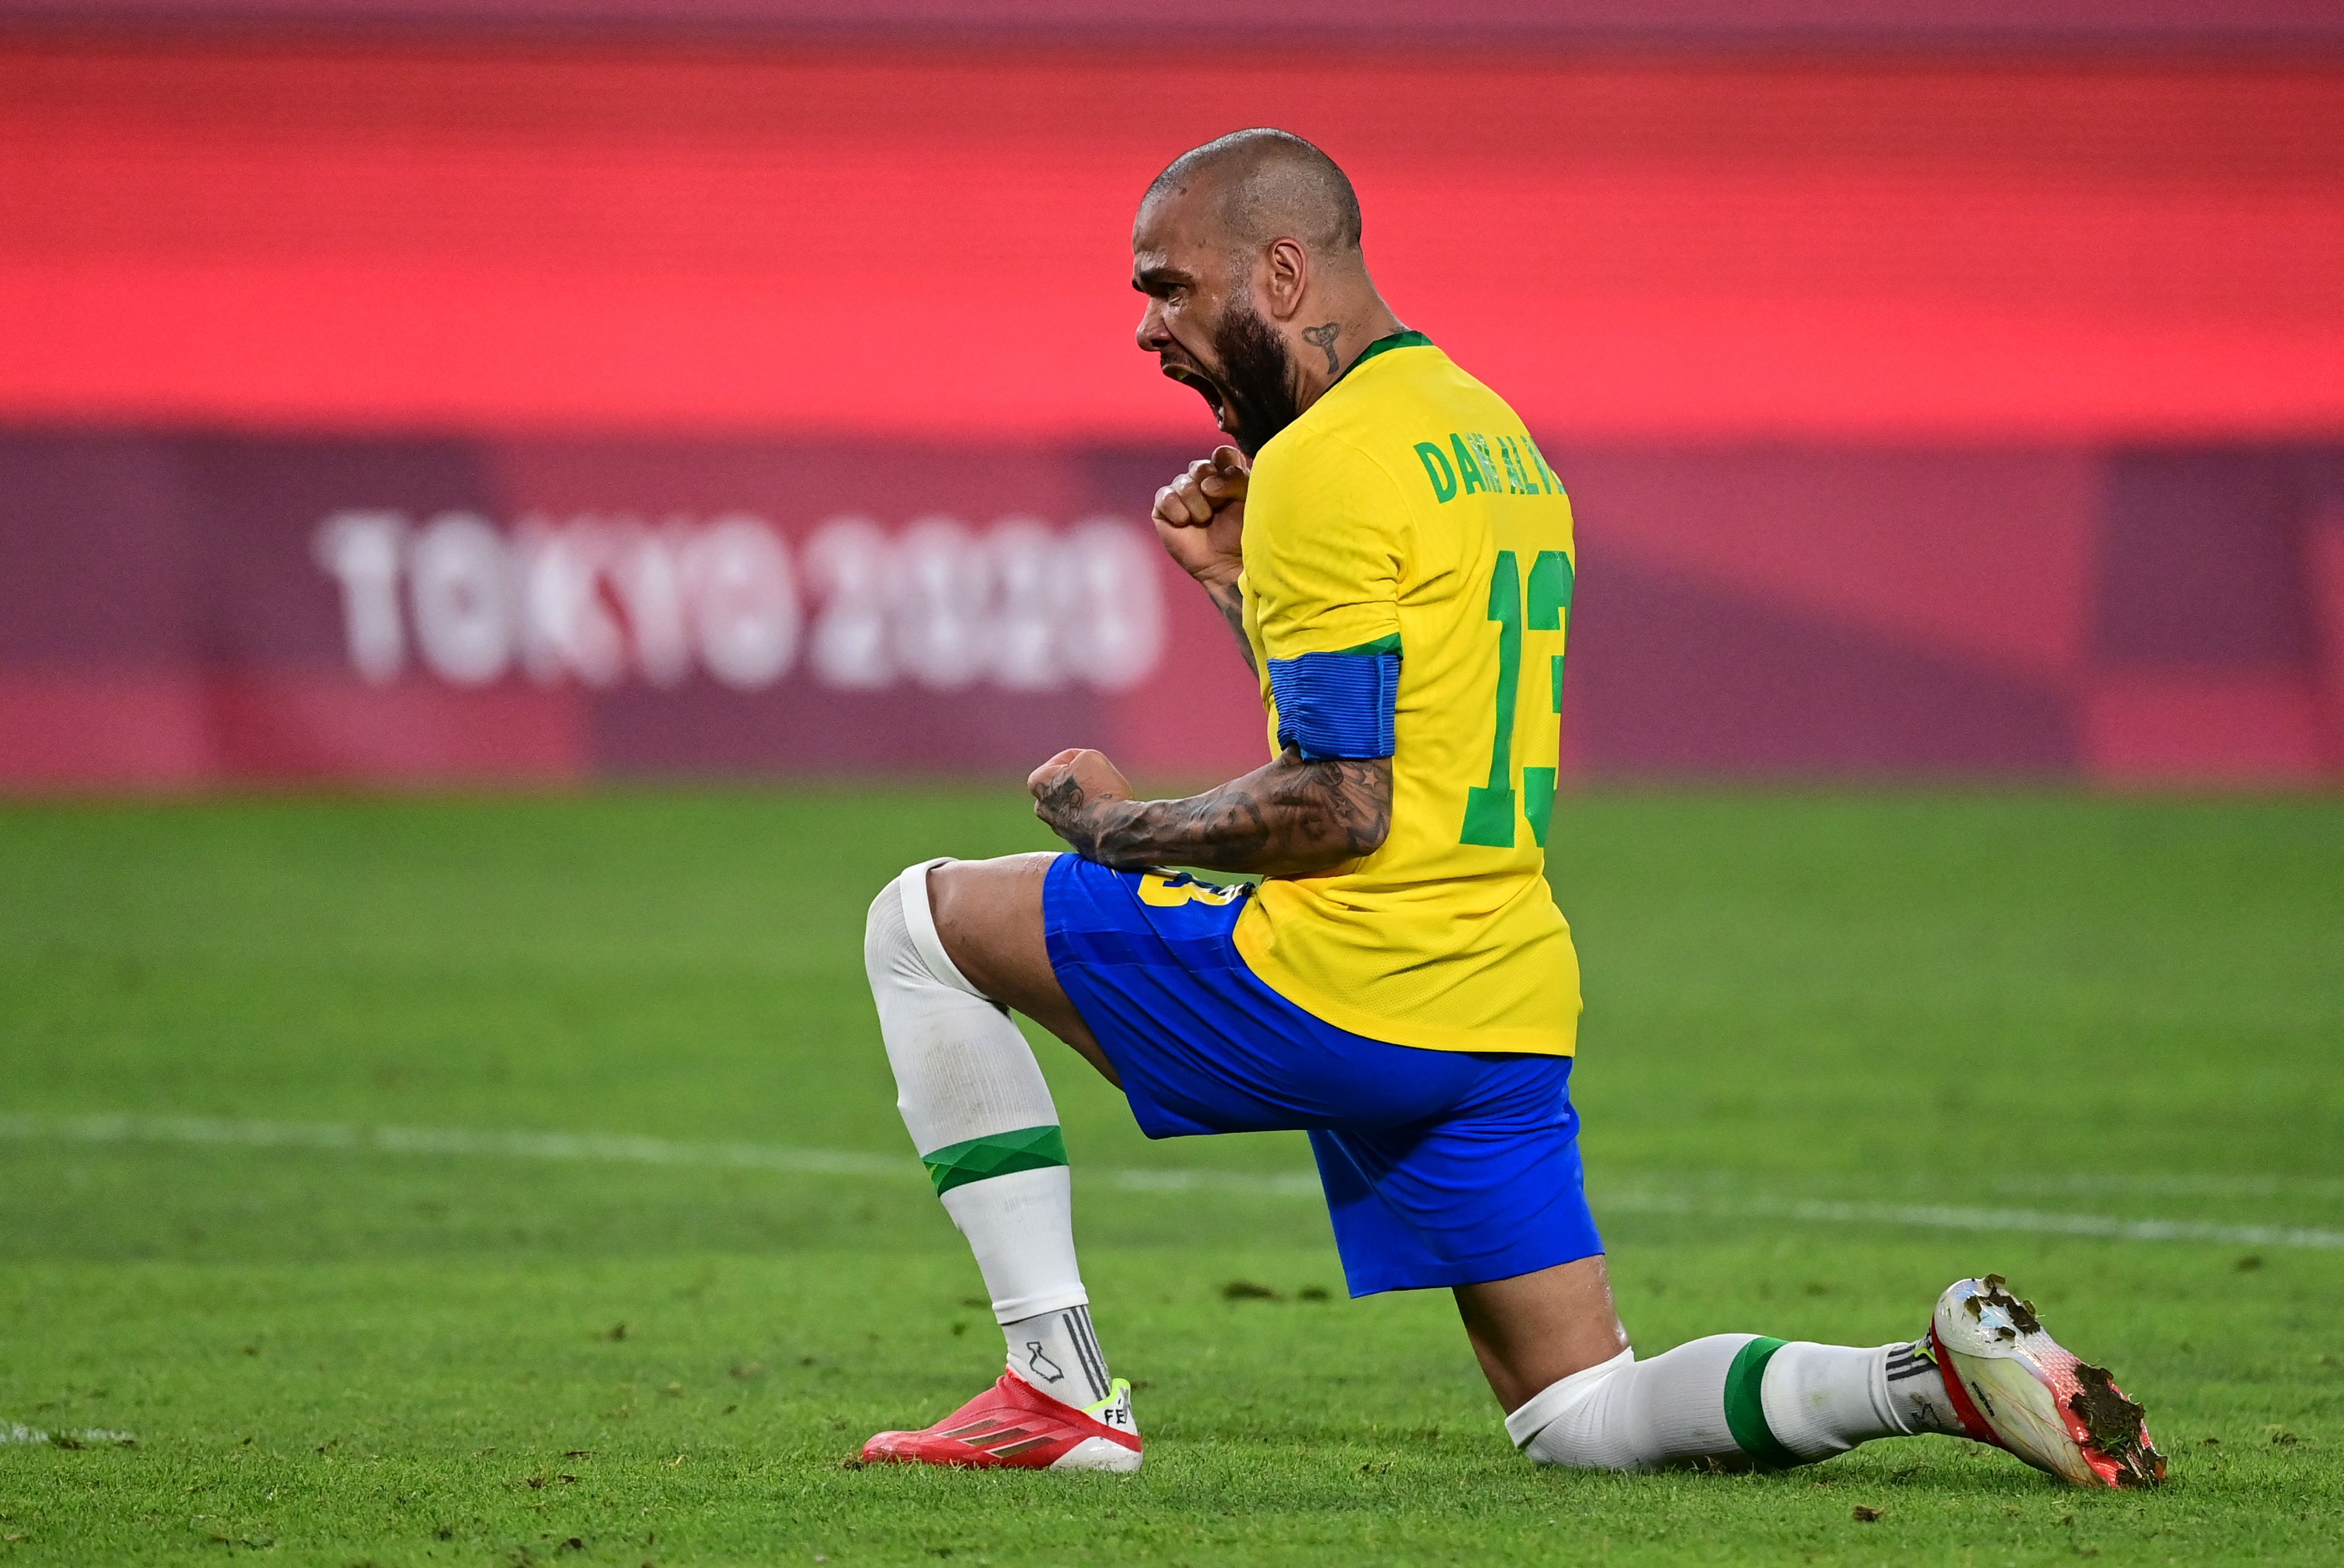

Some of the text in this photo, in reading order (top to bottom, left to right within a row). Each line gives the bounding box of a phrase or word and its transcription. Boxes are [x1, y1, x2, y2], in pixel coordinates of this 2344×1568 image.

[319, 512, 1166, 691] TOKYO 2020
[1459, 550, 1575, 848] 13
